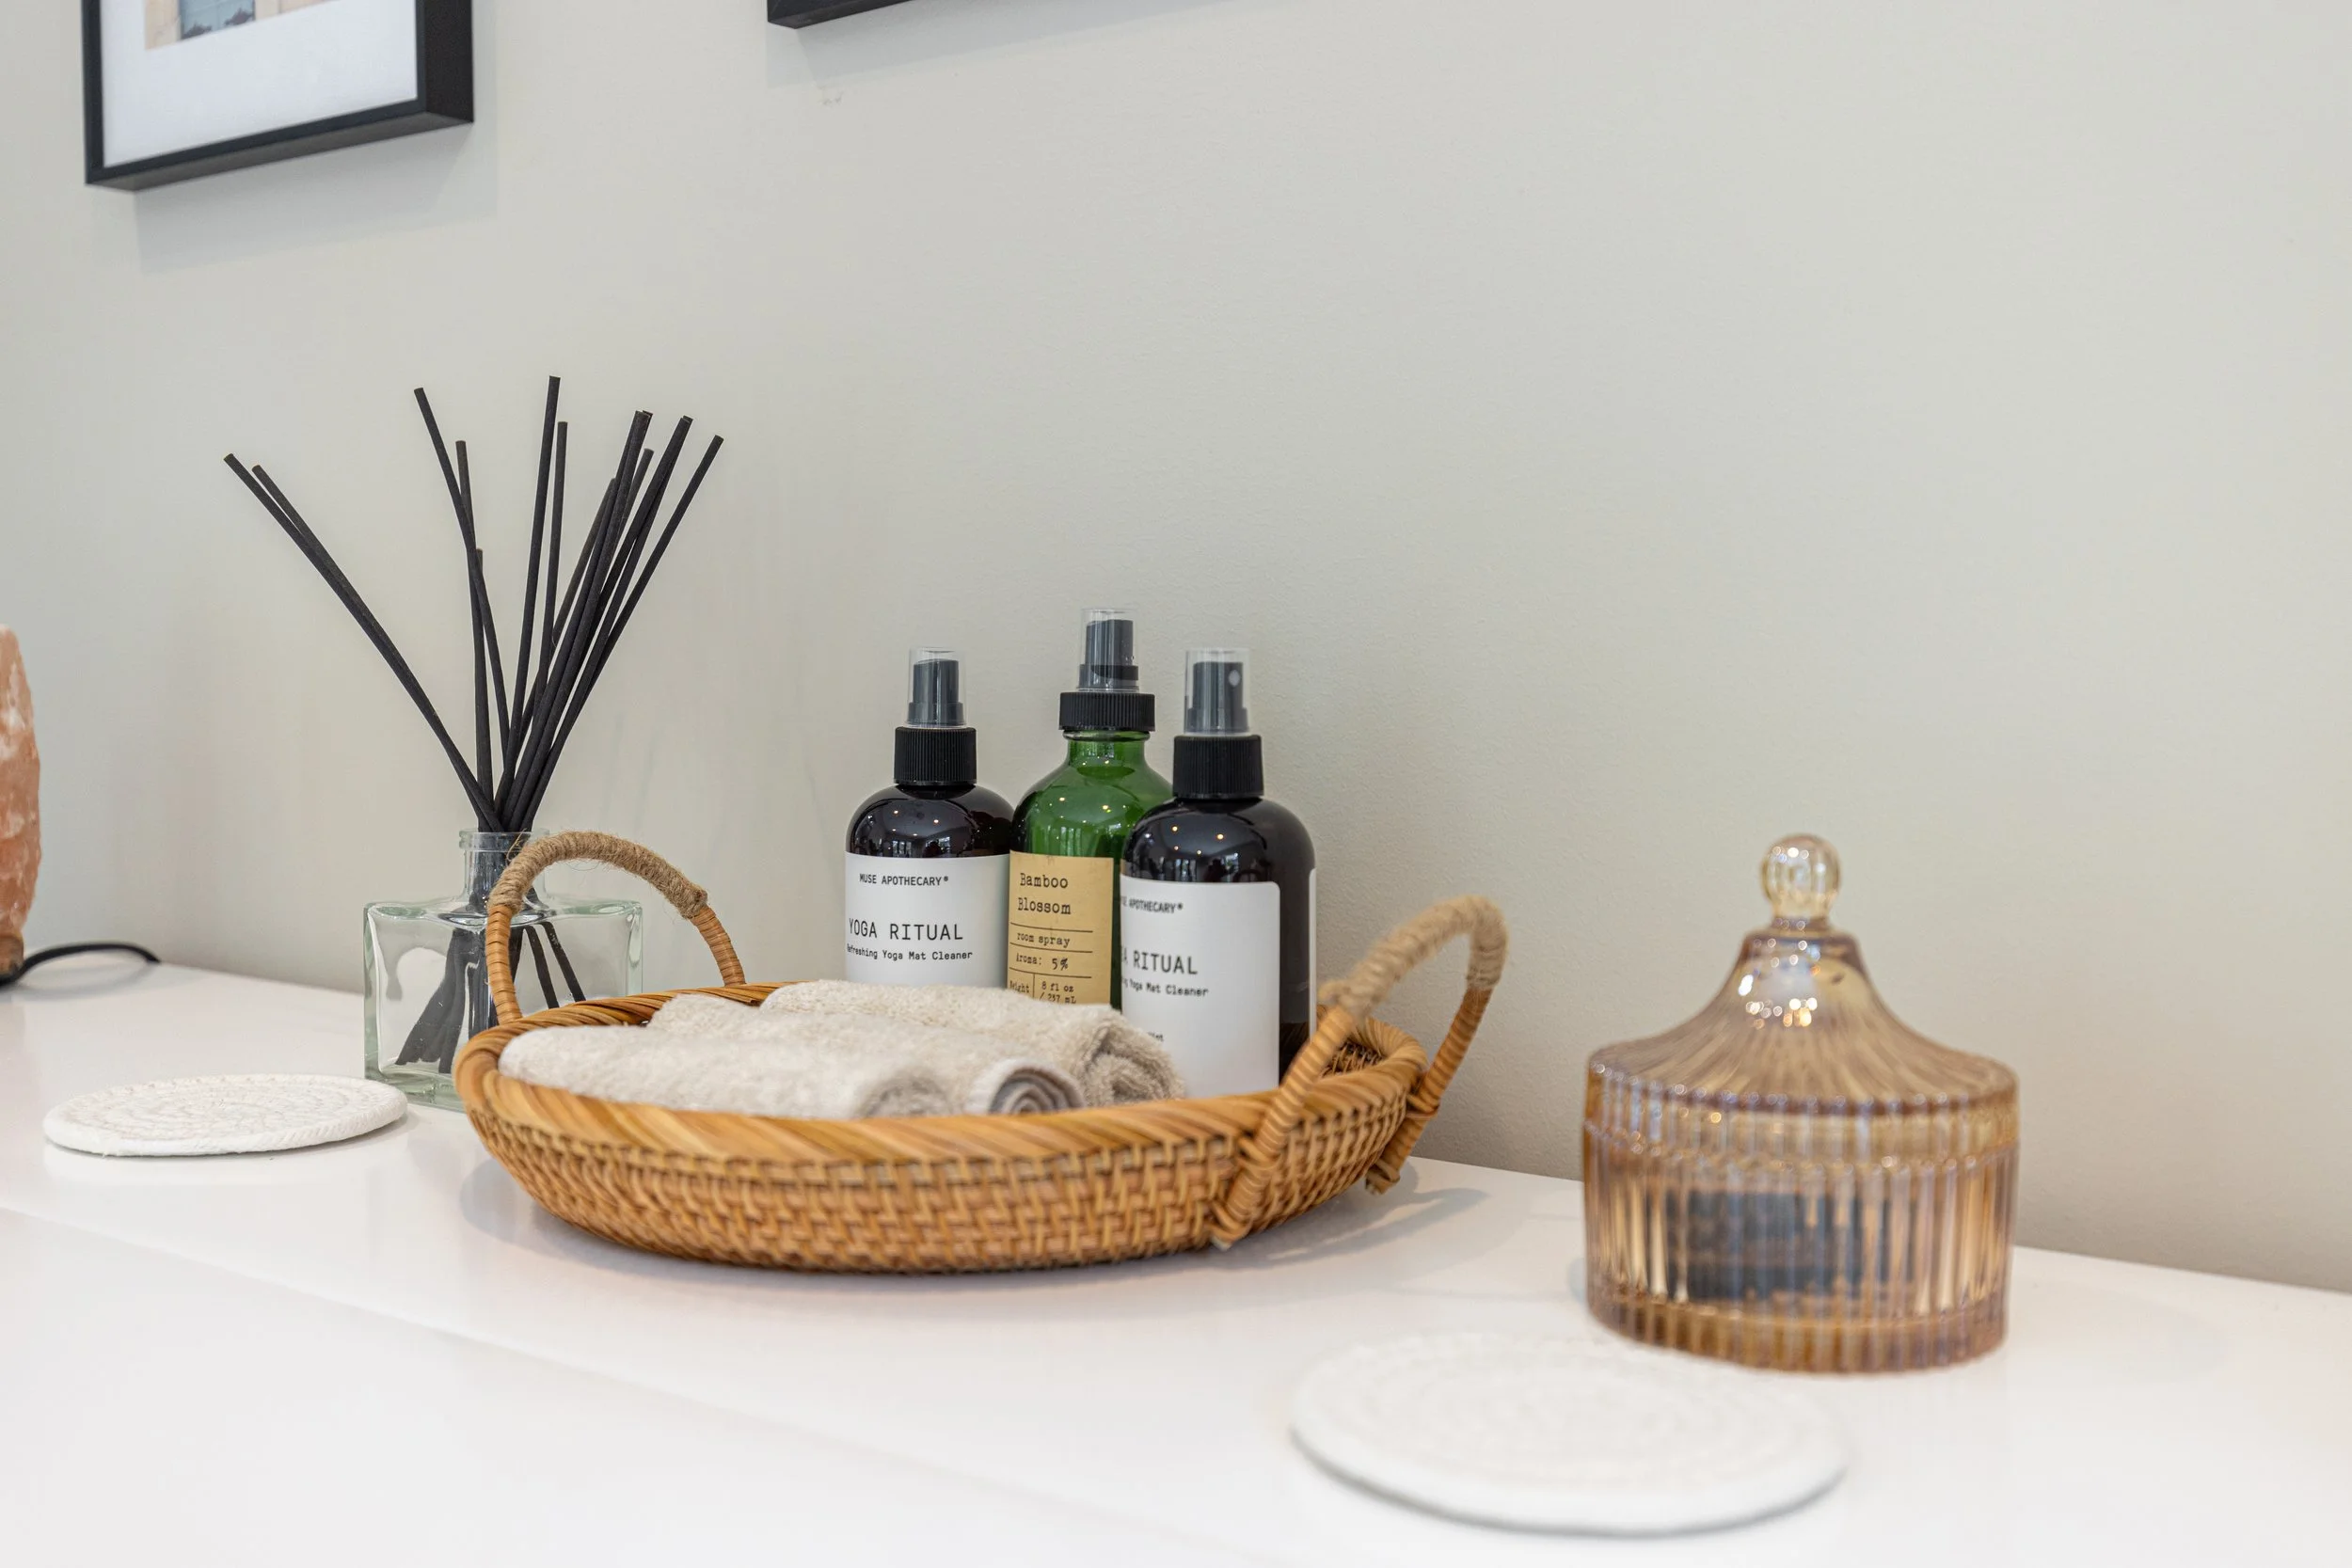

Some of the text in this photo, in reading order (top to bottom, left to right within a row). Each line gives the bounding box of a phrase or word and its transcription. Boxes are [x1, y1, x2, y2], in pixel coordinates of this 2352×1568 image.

[859, 873, 877, 884] MUSE
[1020, 872, 1069, 889] Bamboo
[1017, 897, 1072, 914] Blossom
[849, 917, 963, 941] YOGA RITUAL
[1017, 932, 1071, 948] room spray
[882, 949, 903, 961] Yoga
[908, 950, 927, 960] Mat
[931, 950, 973, 960] Cleaner
[1133, 950, 1198, 975] RITUAL
[1052, 958, 1069, 972] 5%
[1041, 980, 1074, 993] 8 fl oz
[1146, 982, 1161, 994] Mat
[1166, 983, 1209, 997] Cleaner
